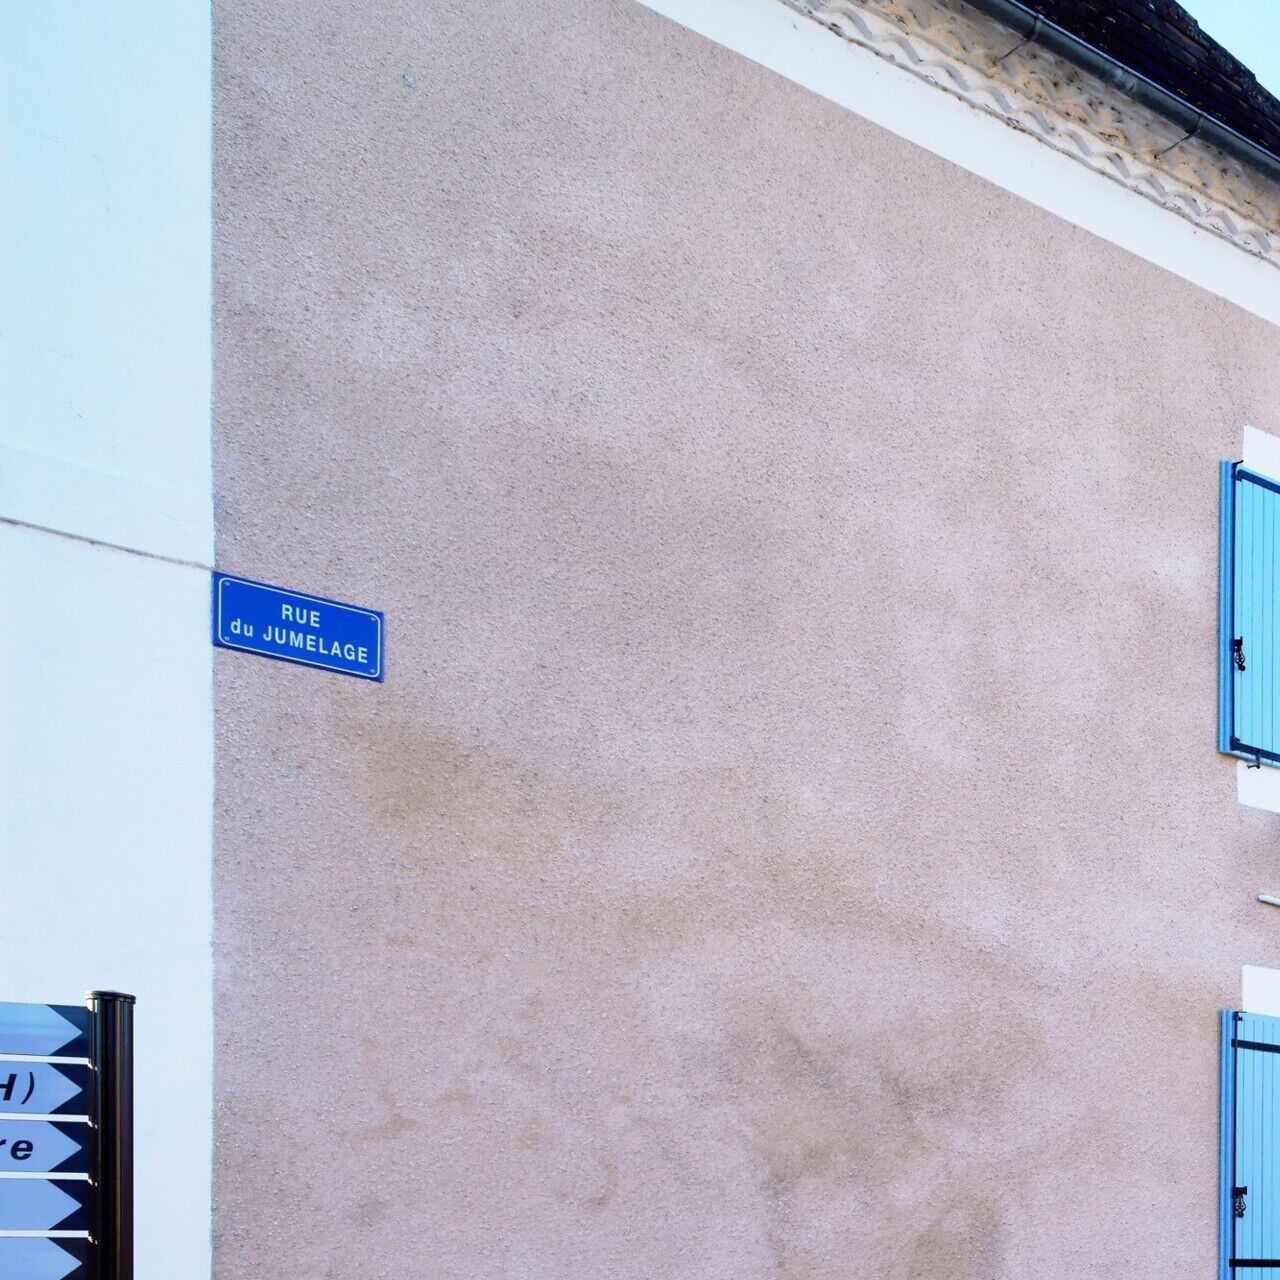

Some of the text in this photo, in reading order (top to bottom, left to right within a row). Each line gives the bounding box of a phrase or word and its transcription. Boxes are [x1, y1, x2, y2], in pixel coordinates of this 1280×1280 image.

[281, 603, 321, 628] RUE
[230, 618, 368, 664] du JUMELAGE
